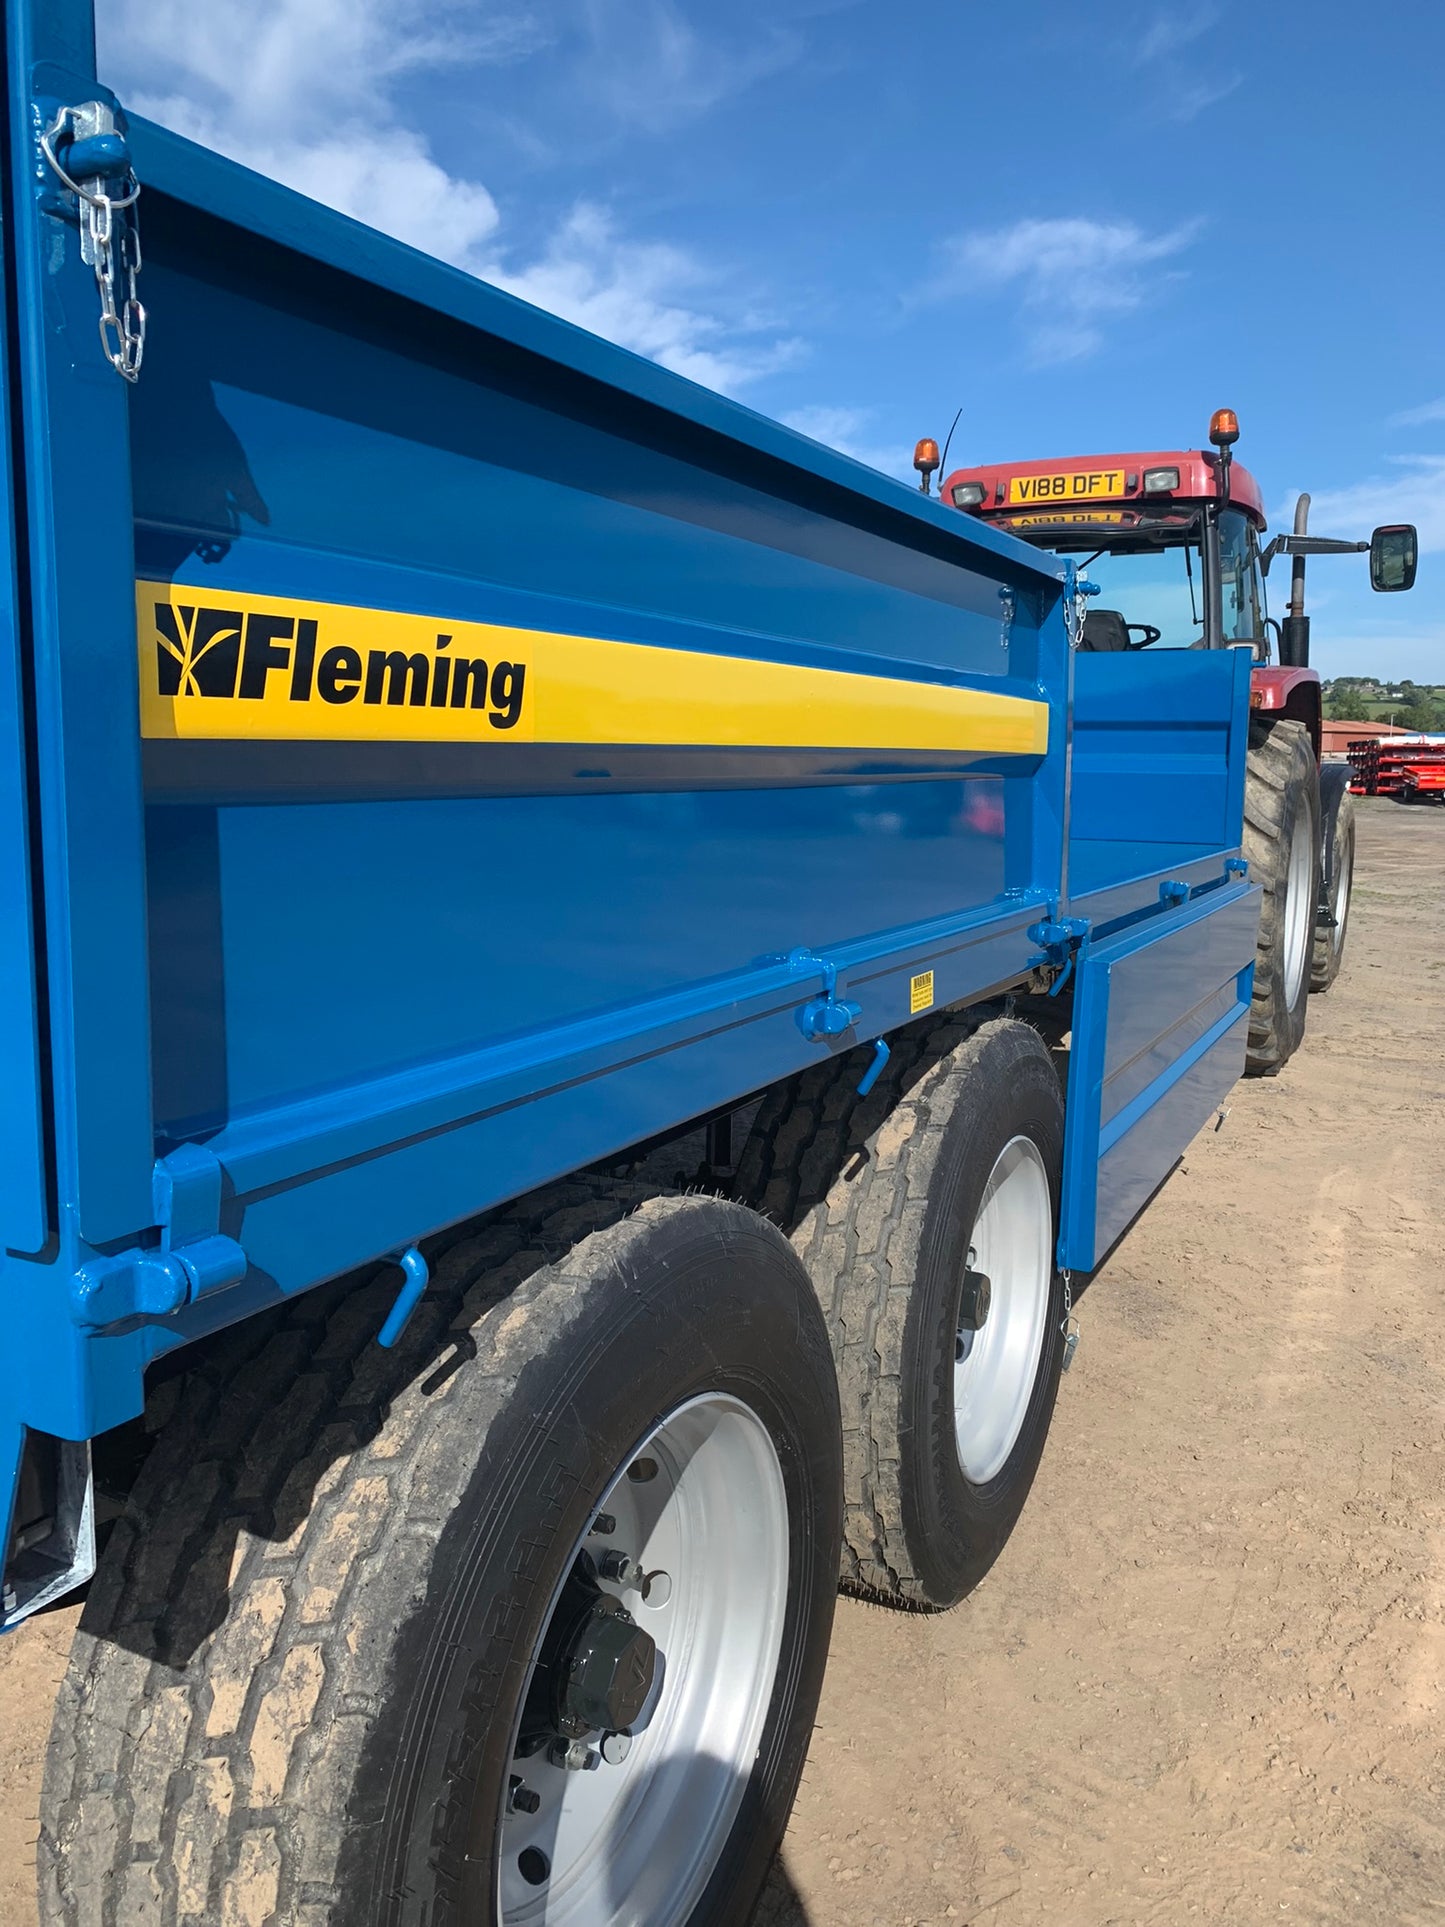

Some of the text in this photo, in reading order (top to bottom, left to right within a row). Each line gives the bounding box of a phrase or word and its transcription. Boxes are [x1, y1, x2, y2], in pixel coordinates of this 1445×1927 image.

[1018, 473, 1118, 498] V188 DFT
[238, 612, 526, 730] Fleming
